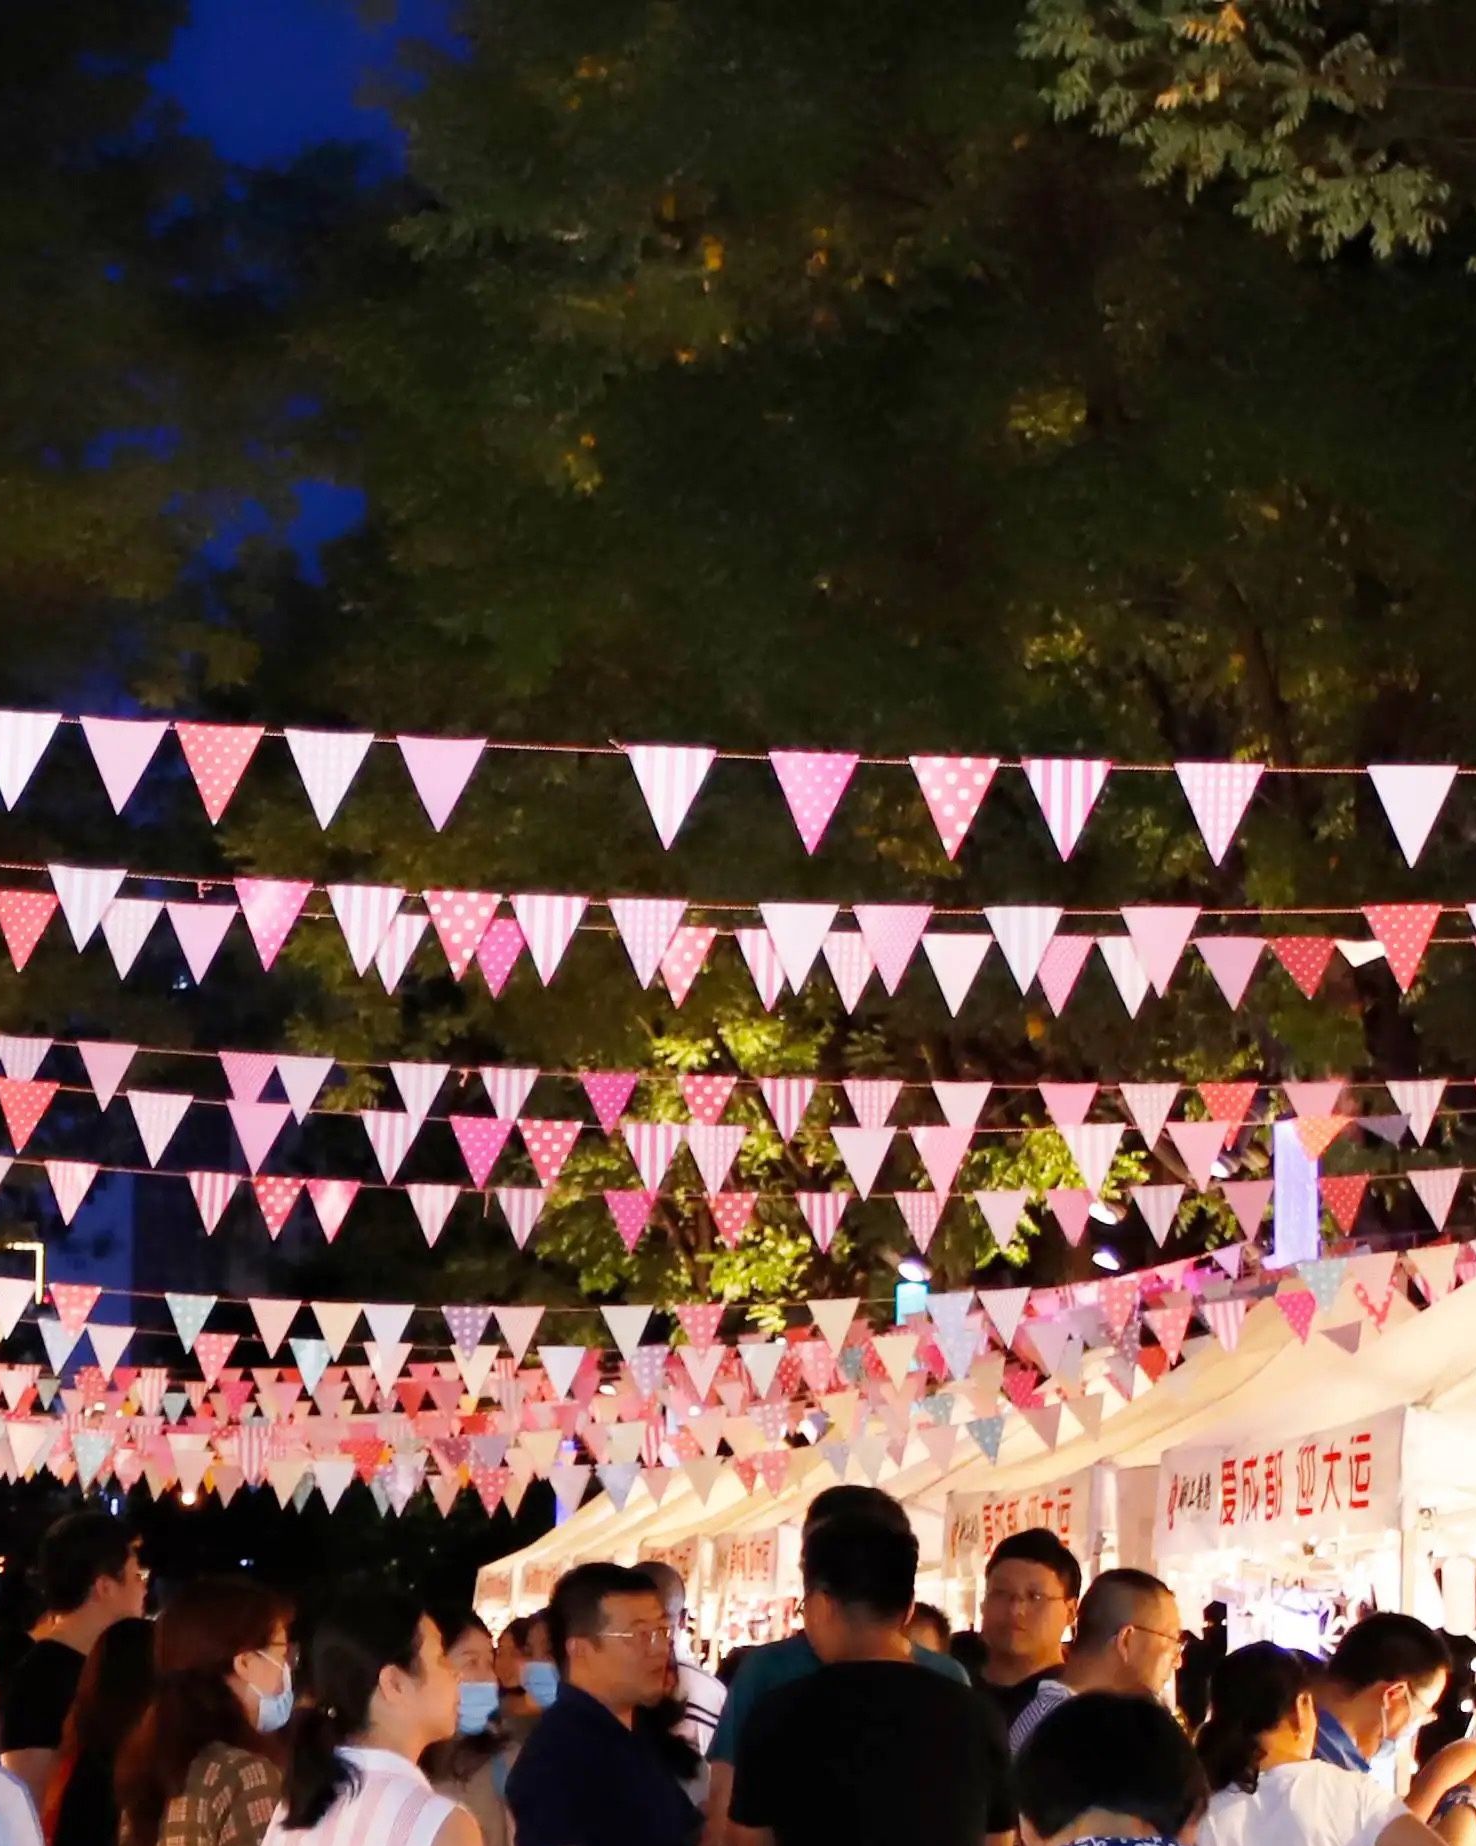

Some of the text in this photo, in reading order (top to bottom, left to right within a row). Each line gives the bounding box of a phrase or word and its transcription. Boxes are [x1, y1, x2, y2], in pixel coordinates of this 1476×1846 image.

[1219, 1433, 1371, 1526] 爱成都 迎大运
